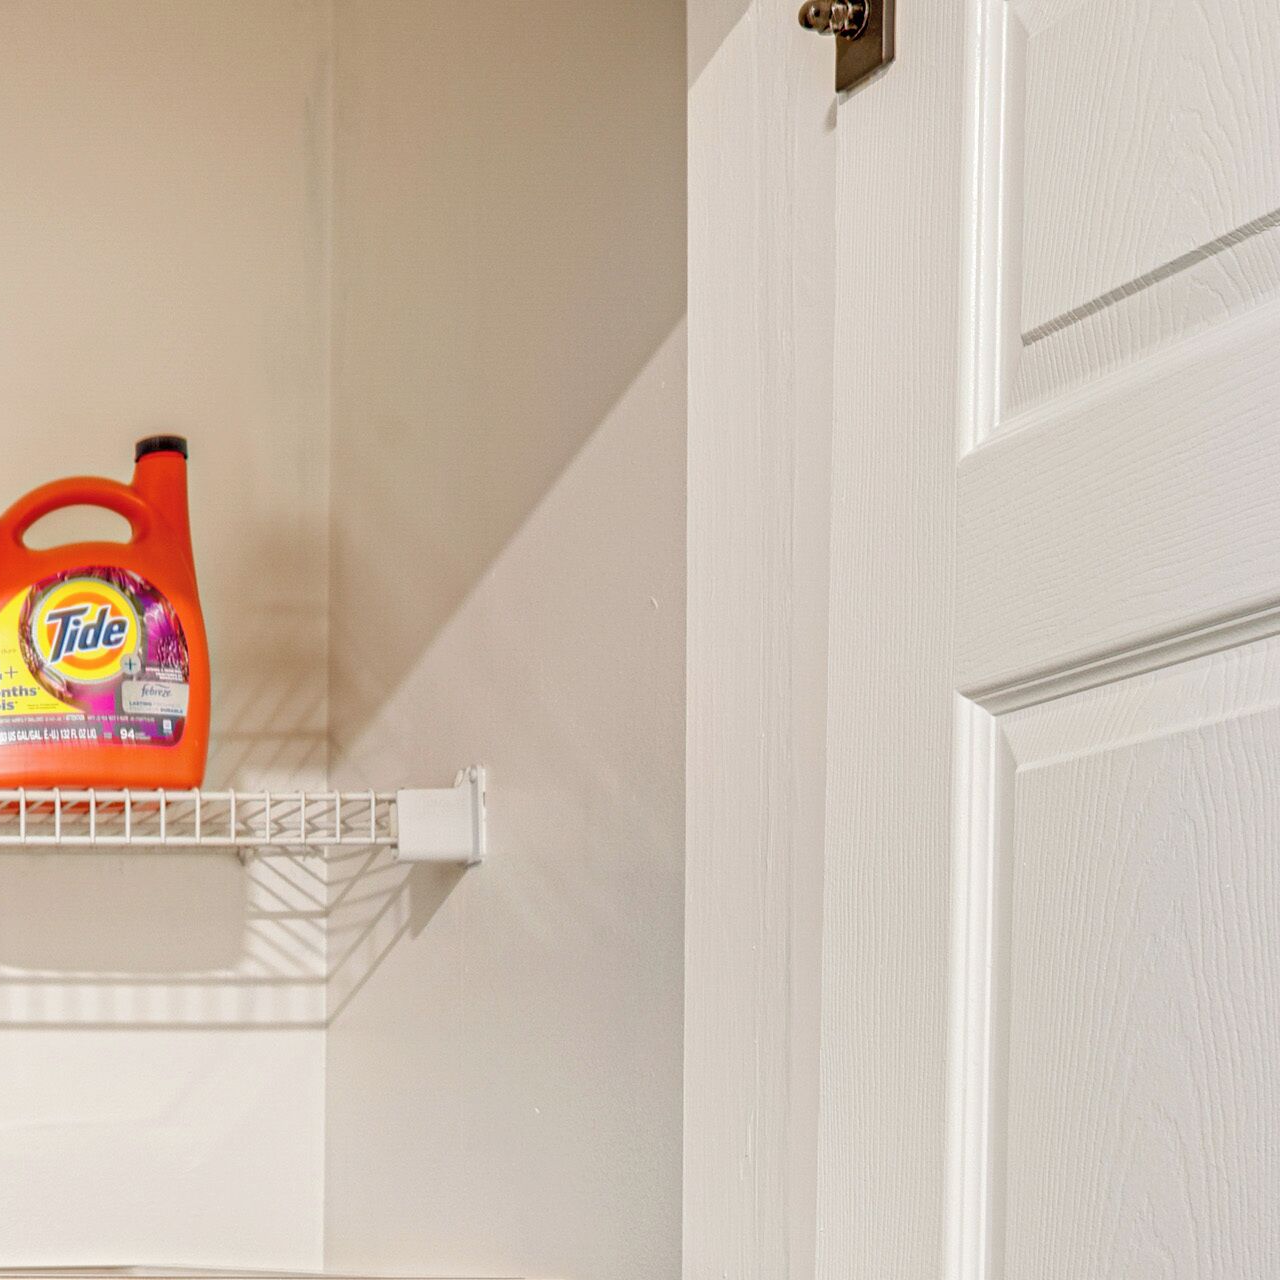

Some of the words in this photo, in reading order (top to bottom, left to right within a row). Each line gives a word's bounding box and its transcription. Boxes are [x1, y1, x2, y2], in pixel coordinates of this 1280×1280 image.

[45, 603, 129, 665] Tide
[141, 684, 172, 697] febreze
[120, 728, 135, 740] 94
